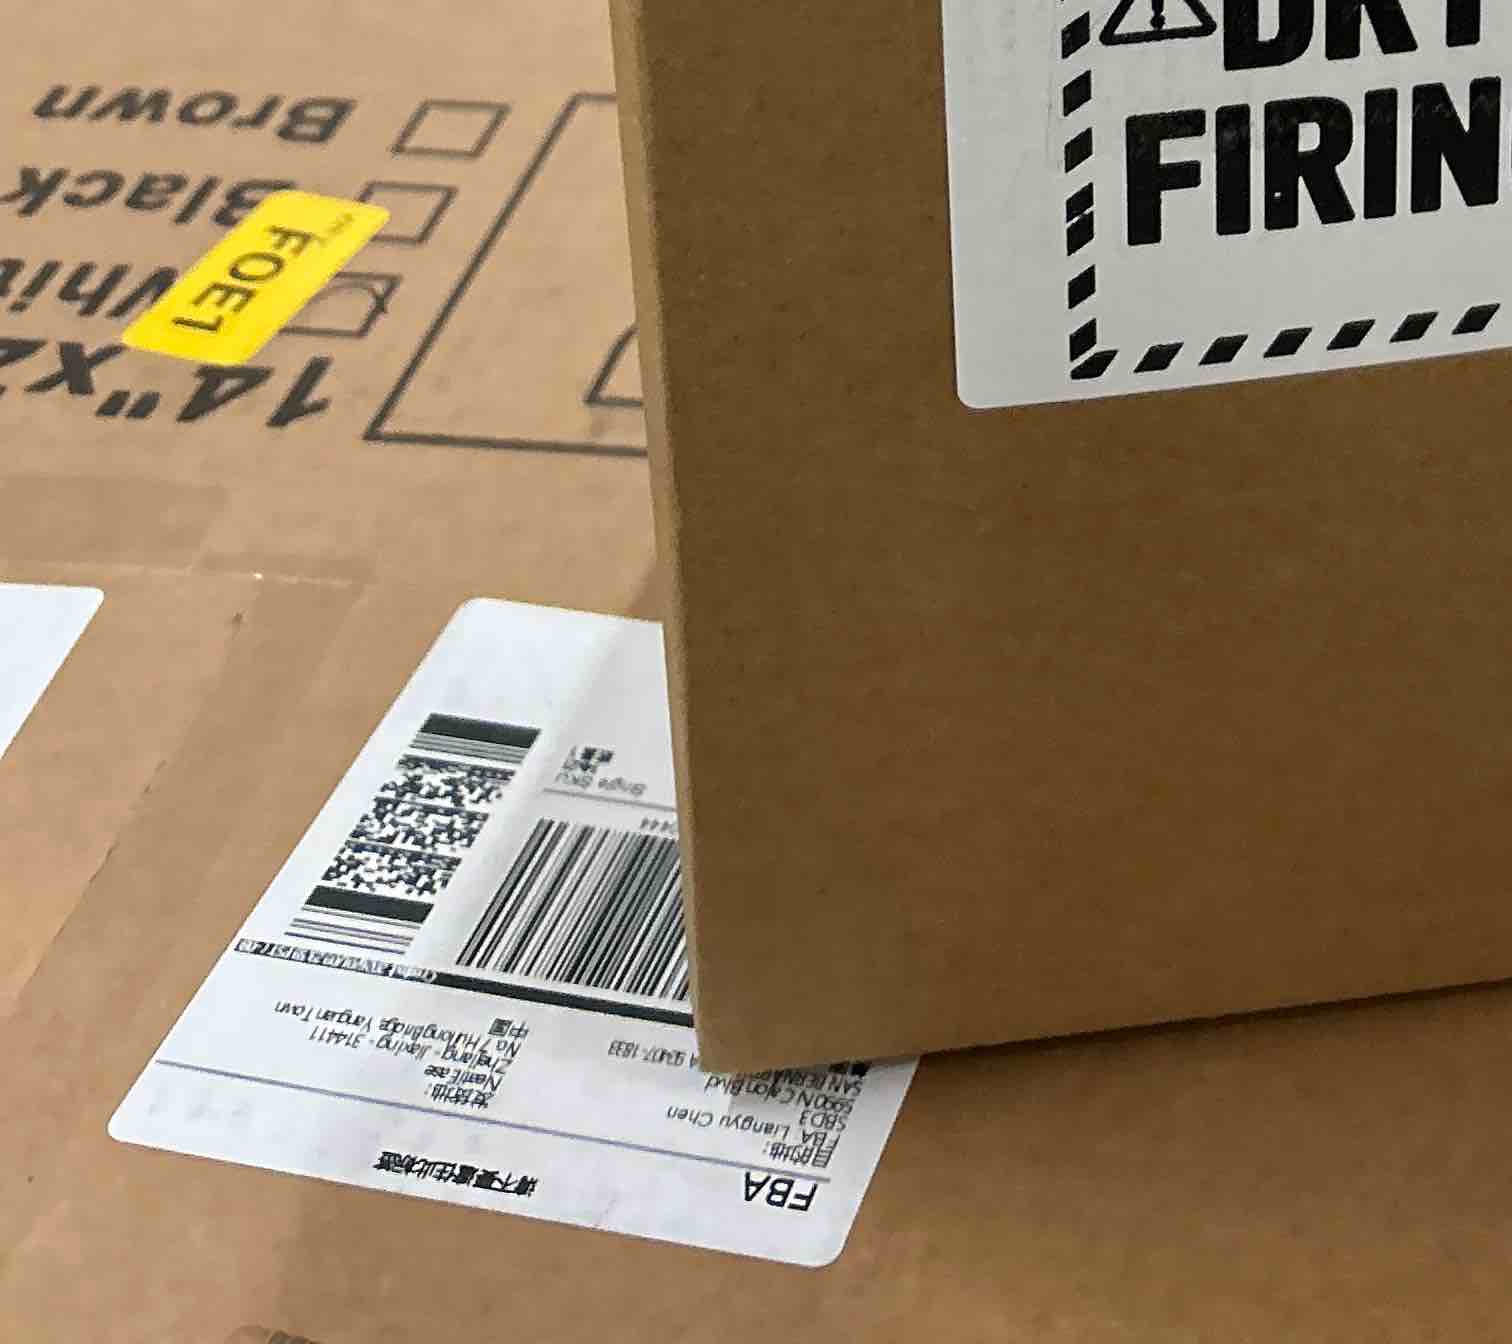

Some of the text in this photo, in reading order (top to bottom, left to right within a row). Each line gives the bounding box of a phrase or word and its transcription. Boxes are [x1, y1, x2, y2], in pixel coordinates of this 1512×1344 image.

[32, 85, 358, 145] Brown
[703, 1075, 747, 1096] Blvd
[666, 1105, 715, 1128] Chen
[719, 1112, 790, 1140] Liangyu
[799, 1110, 848, 1131] SBD3
[743, 1171, 819, 1212] FBA
